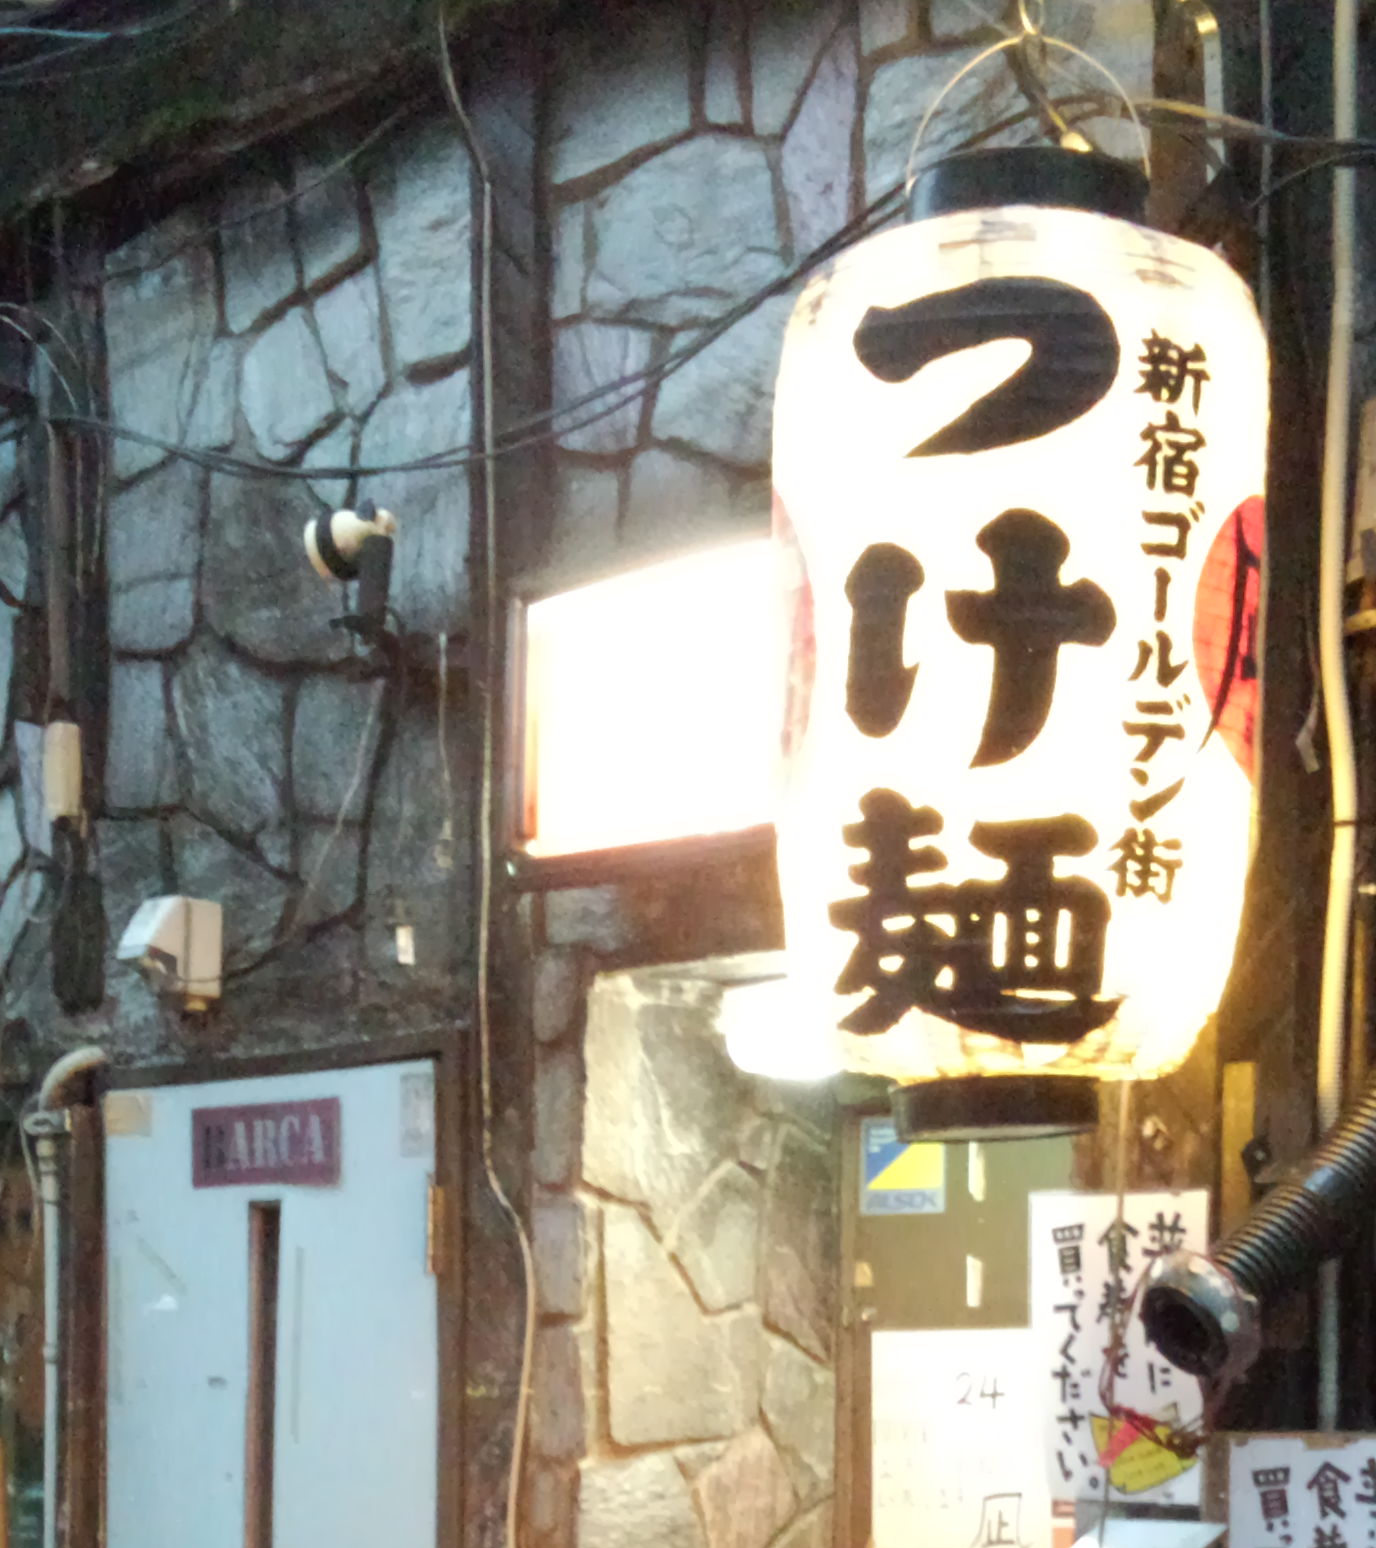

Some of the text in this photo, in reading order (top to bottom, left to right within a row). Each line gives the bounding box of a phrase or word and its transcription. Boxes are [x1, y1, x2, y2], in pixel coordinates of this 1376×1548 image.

[829, 275, 1122, 1044] つけ麺
[1108, 328, 1211, 905] 新宿ゴールデン街
[201, 1114, 325, 1171] BARCA
